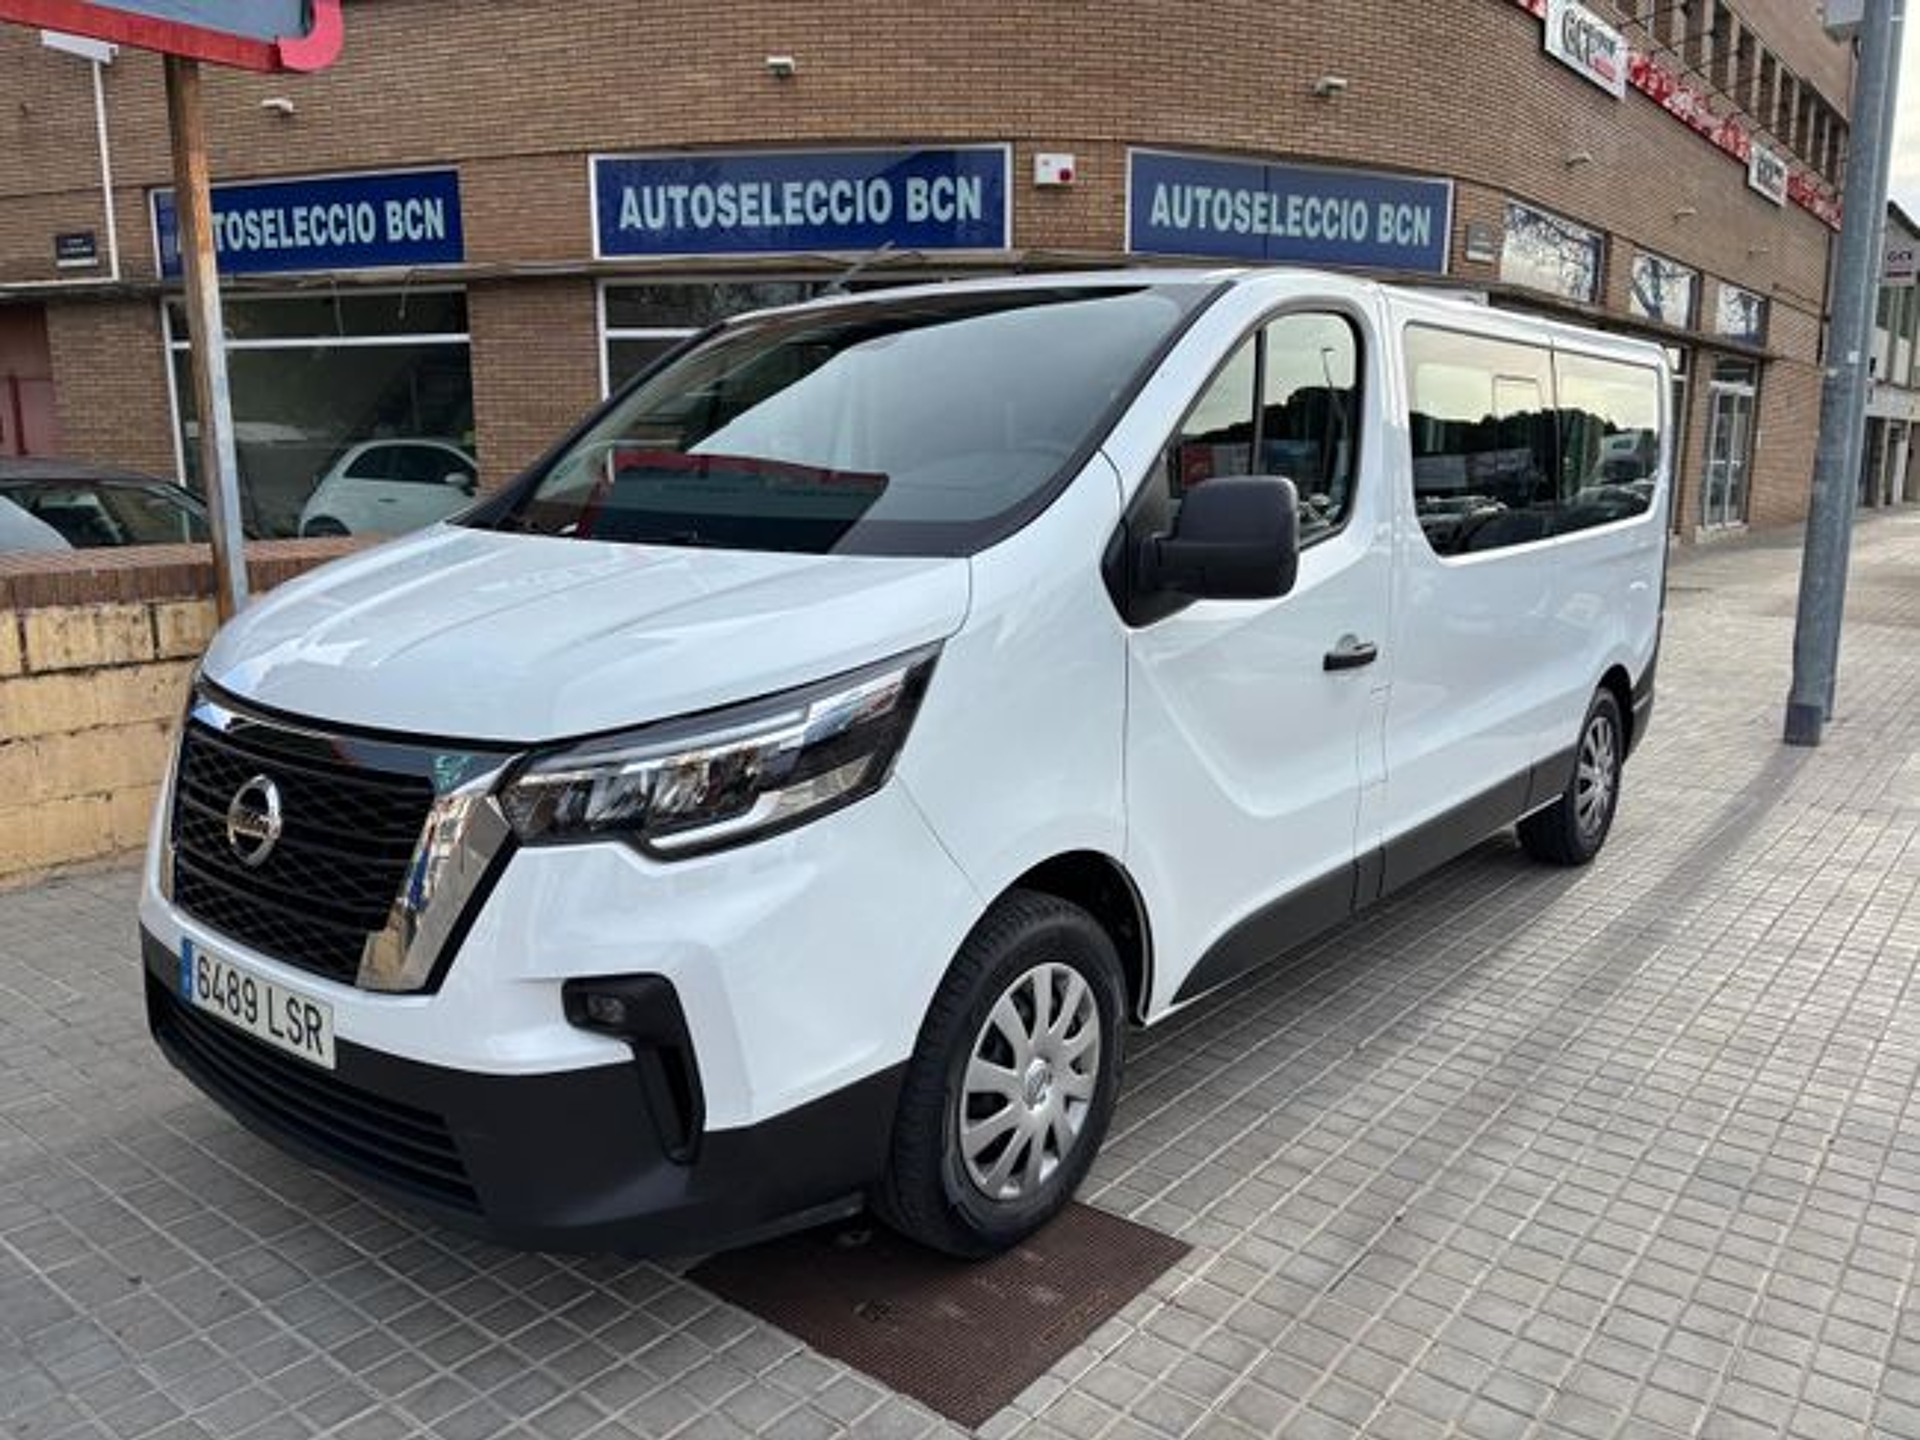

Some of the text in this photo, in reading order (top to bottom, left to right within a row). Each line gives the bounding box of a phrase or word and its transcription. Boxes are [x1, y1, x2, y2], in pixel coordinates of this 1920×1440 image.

[177, 197, 445, 252] TOSELECCIO BCN
[619, 176, 982, 230] AUTOSELECCIO BCN
[1150, 182, 1431, 247] AUTOSELECCIO BCN
[197, 955, 323, 1056] 6489 LSR
